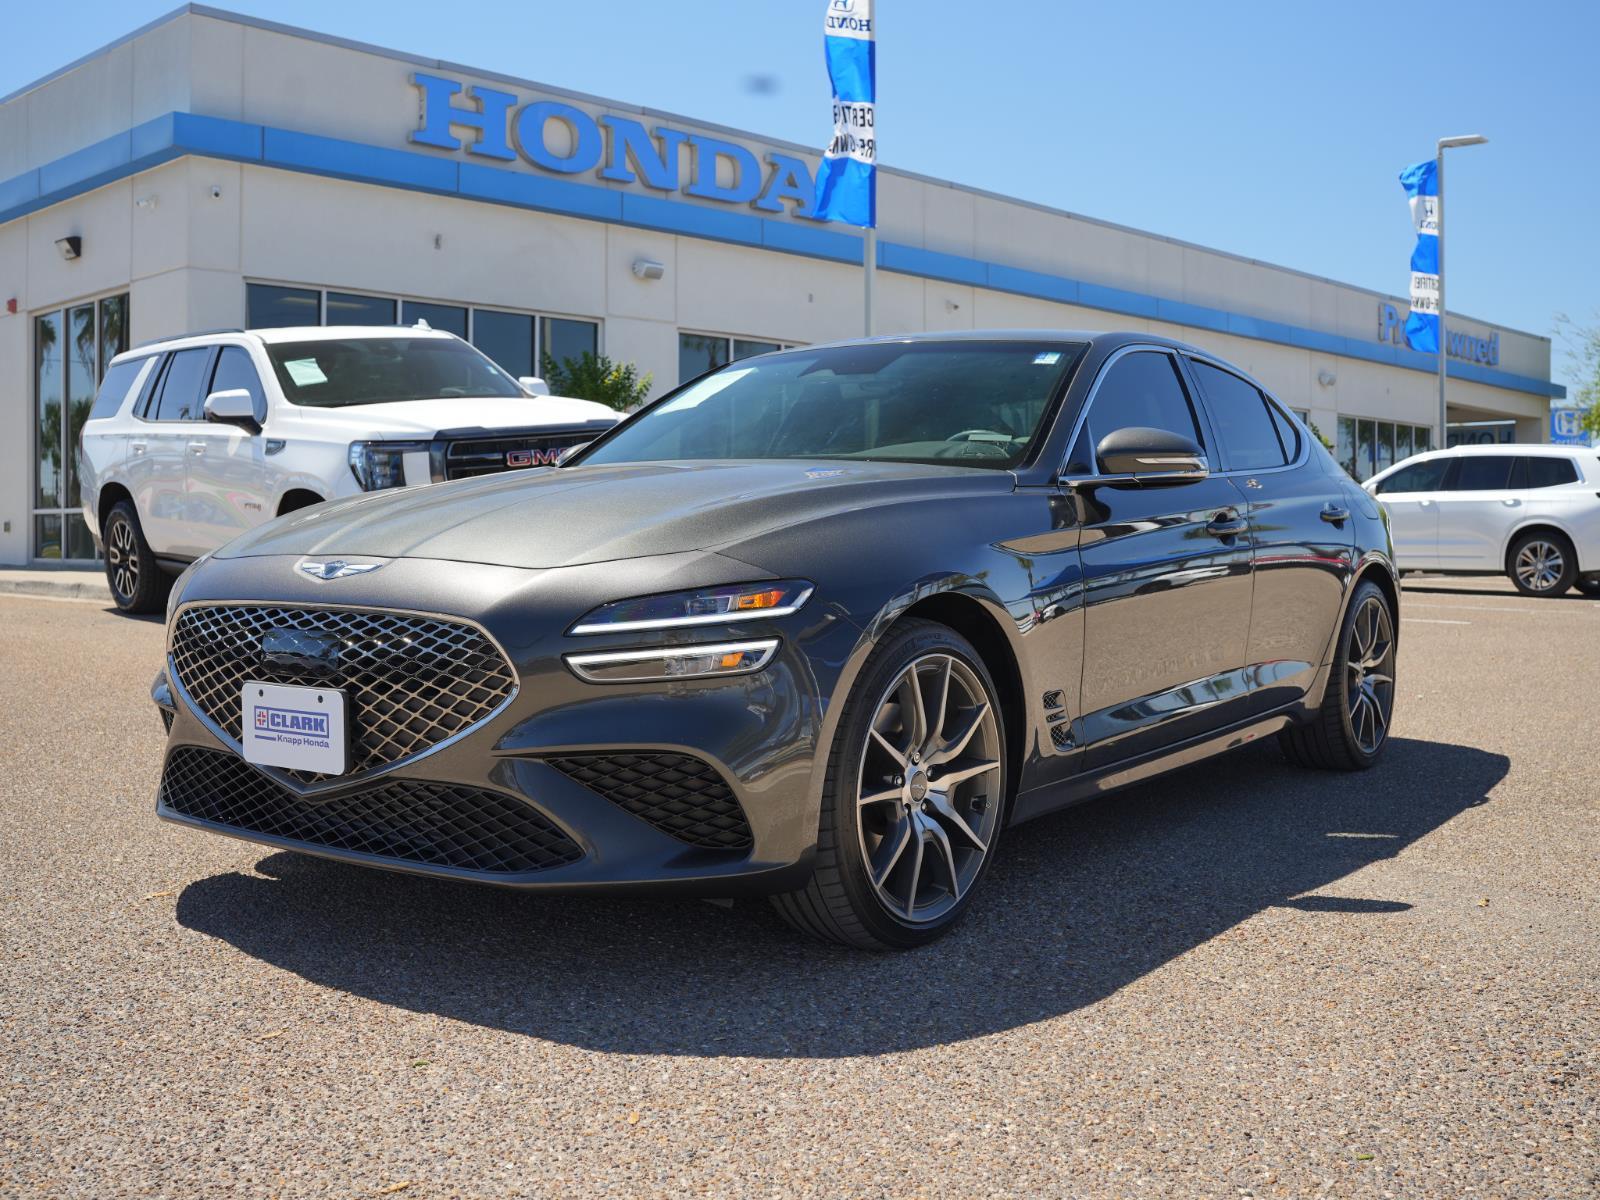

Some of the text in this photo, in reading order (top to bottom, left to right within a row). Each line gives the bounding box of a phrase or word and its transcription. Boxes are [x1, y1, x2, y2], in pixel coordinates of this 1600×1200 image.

[408, 72, 819, 222] HONDA
[506, 447, 568, 467] GM
[270, 713, 326, 733] CLARK
[276, 734, 330, 749] Knapp Honda
